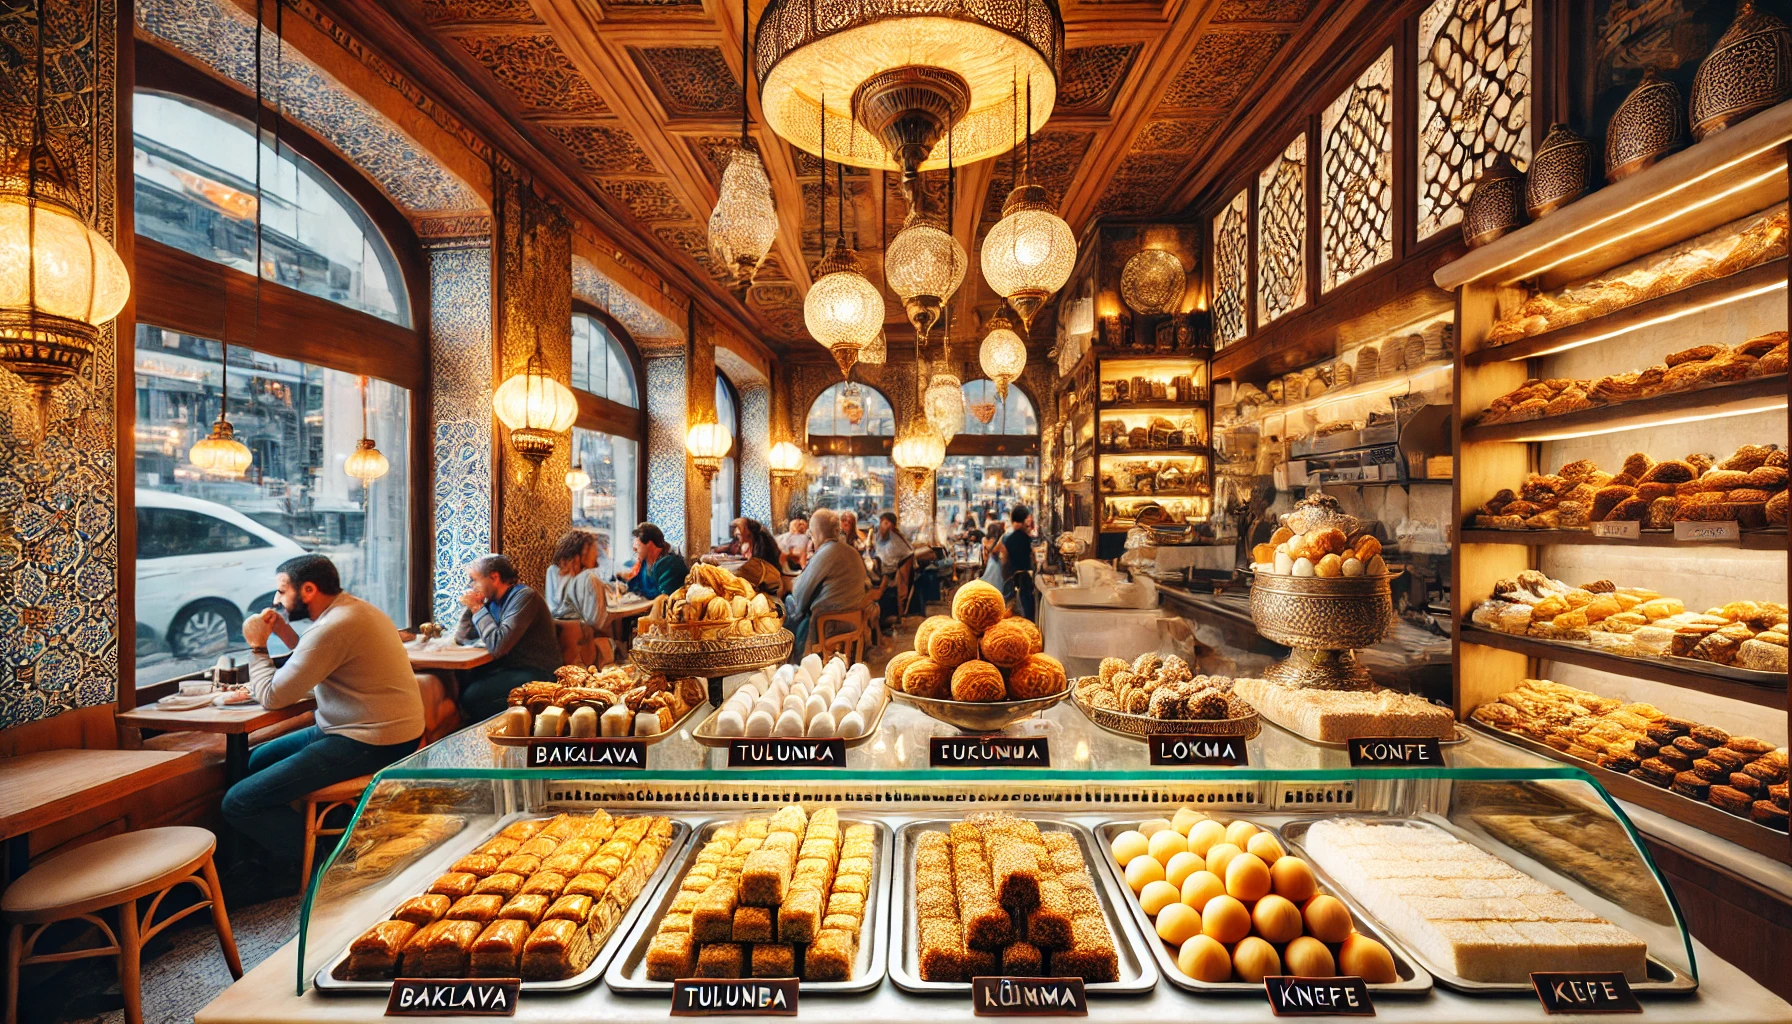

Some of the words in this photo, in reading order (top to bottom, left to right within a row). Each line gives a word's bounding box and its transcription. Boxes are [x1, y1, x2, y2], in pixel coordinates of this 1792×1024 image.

[1161, 741, 1236, 759] LOKMA
[400, 985, 506, 1008] BAKLAVA
[1280, 980, 1359, 1007] KNEFE
